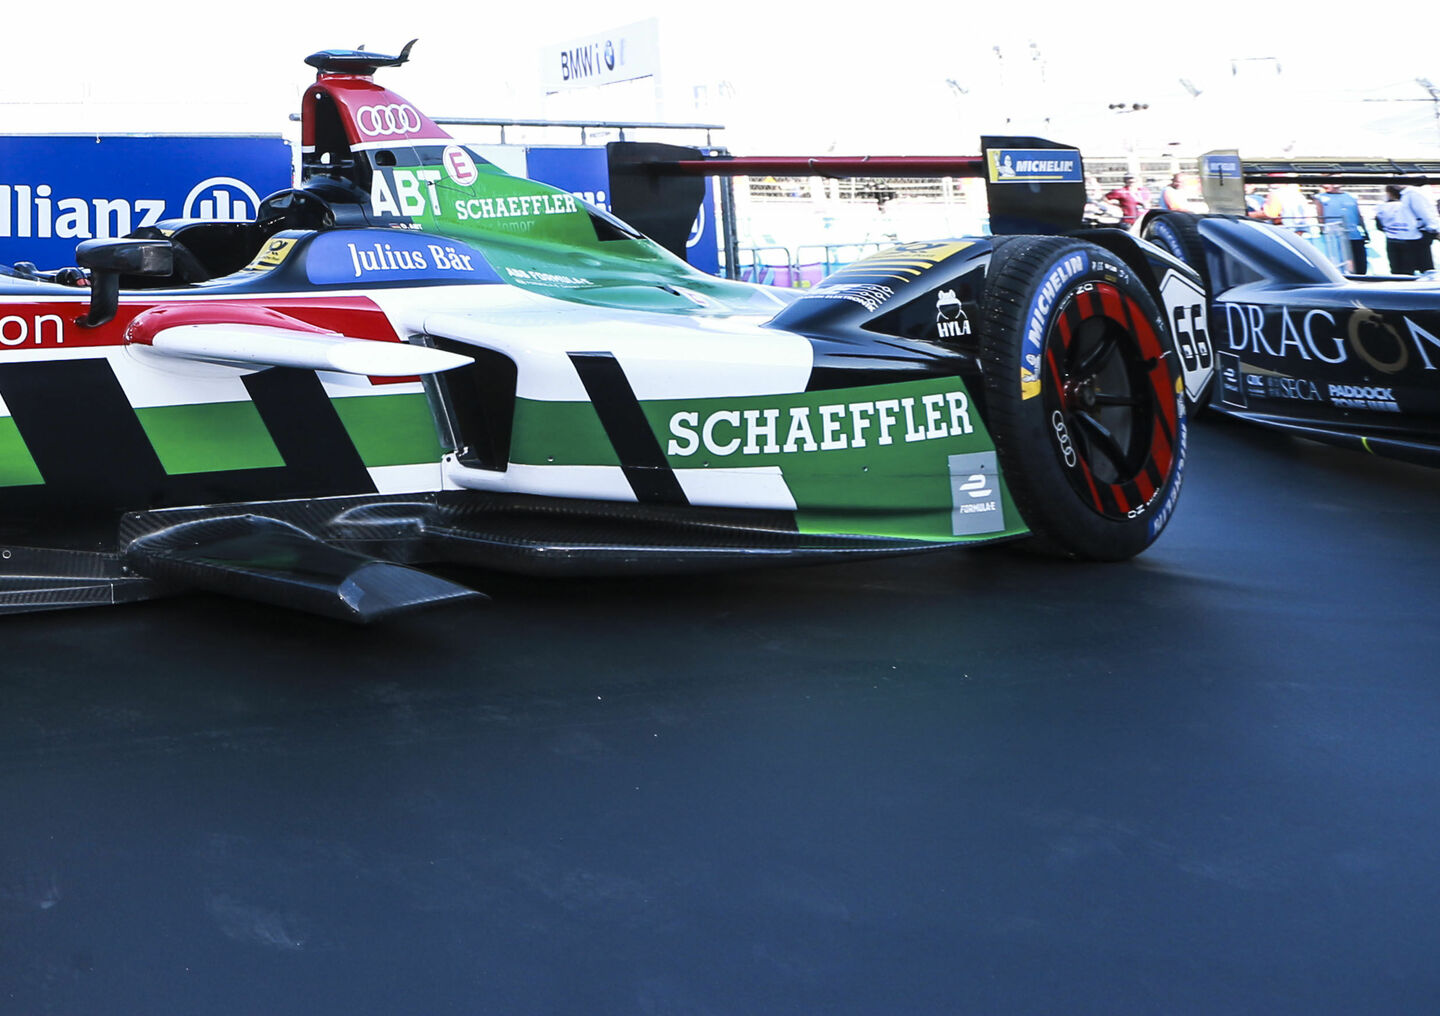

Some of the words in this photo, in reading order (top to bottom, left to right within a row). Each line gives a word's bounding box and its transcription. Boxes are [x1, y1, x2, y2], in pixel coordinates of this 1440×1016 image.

[561, 45, 593, 81] BMW
[450, 151, 472, 179] E
[1015, 160, 1074, 173] MICHELIN
[370, 169, 442, 217] ABT
[454, 194, 578, 221] SCHAEFFLER
[348, 243, 427, 277] Julius
[428, 245, 474, 272] Bär
[1028, 255, 1084, 349] MICHELIN
[937, 319, 972, 338] HYLA
[1173, 304, 1212, 372] 66
[667, 391, 974, 456] SCHAEFFLER
